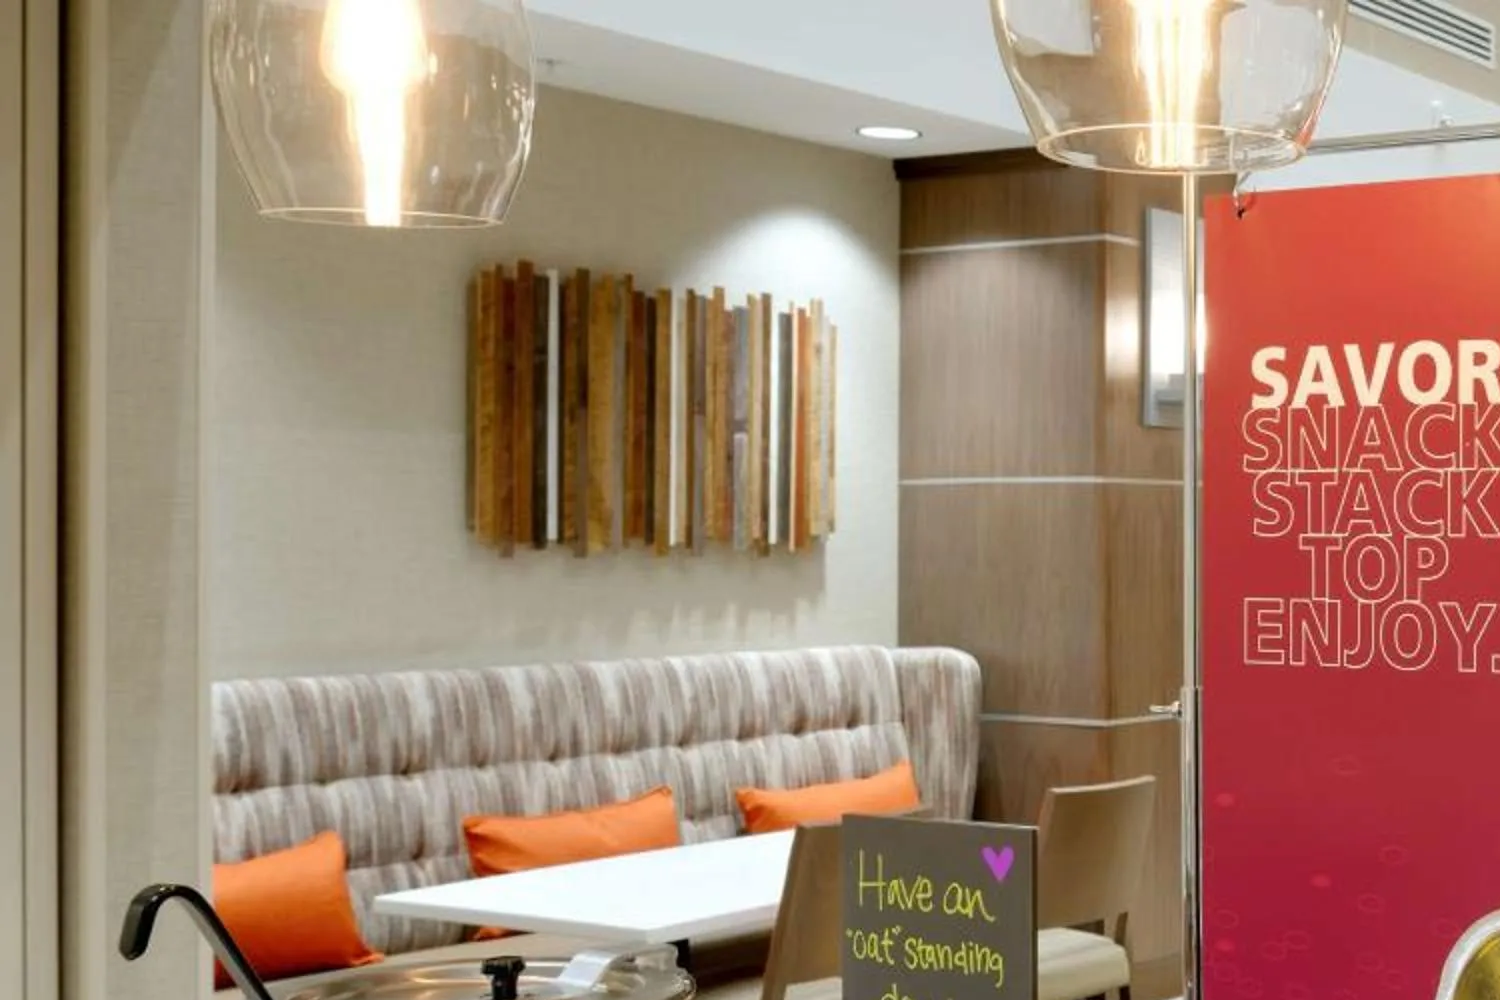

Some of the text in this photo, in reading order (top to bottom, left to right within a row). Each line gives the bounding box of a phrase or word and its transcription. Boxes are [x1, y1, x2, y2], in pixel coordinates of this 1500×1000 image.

[1299, 533, 1449, 603] TOP
[859, 848, 996, 922] Have an
